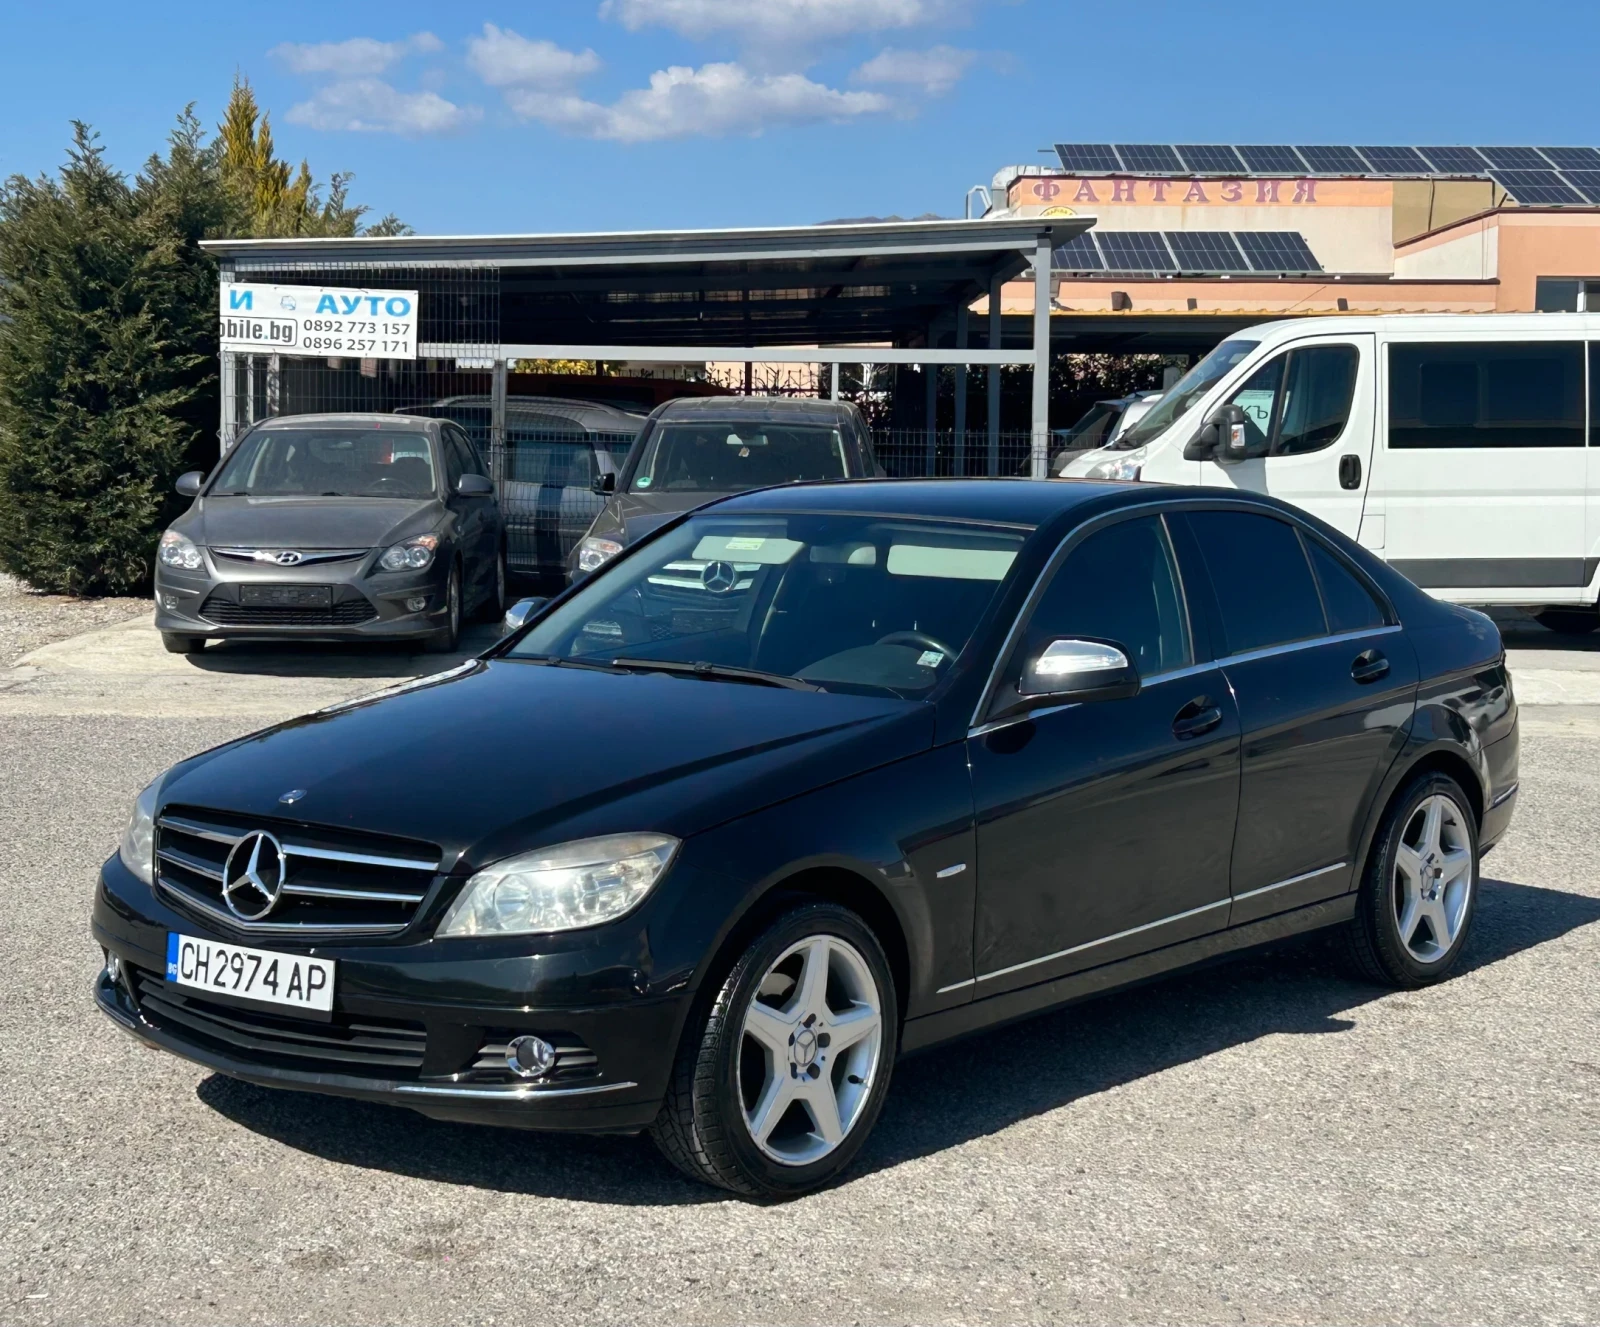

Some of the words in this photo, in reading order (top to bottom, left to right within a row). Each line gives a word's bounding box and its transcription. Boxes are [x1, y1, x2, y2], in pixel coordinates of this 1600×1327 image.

[1032, 178, 1318, 203] ФАНТАЗИЯ
[315, 294, 412, 317] АУТО
[303, 319, 343, 333] 0892
[348, 321, 376, 334] 773
[382, 323, 410, 336] 157
[303, 336, 343, 350] 0896
[347, 338, 376, 351] 257
[382, 340, 408, 353] 171
